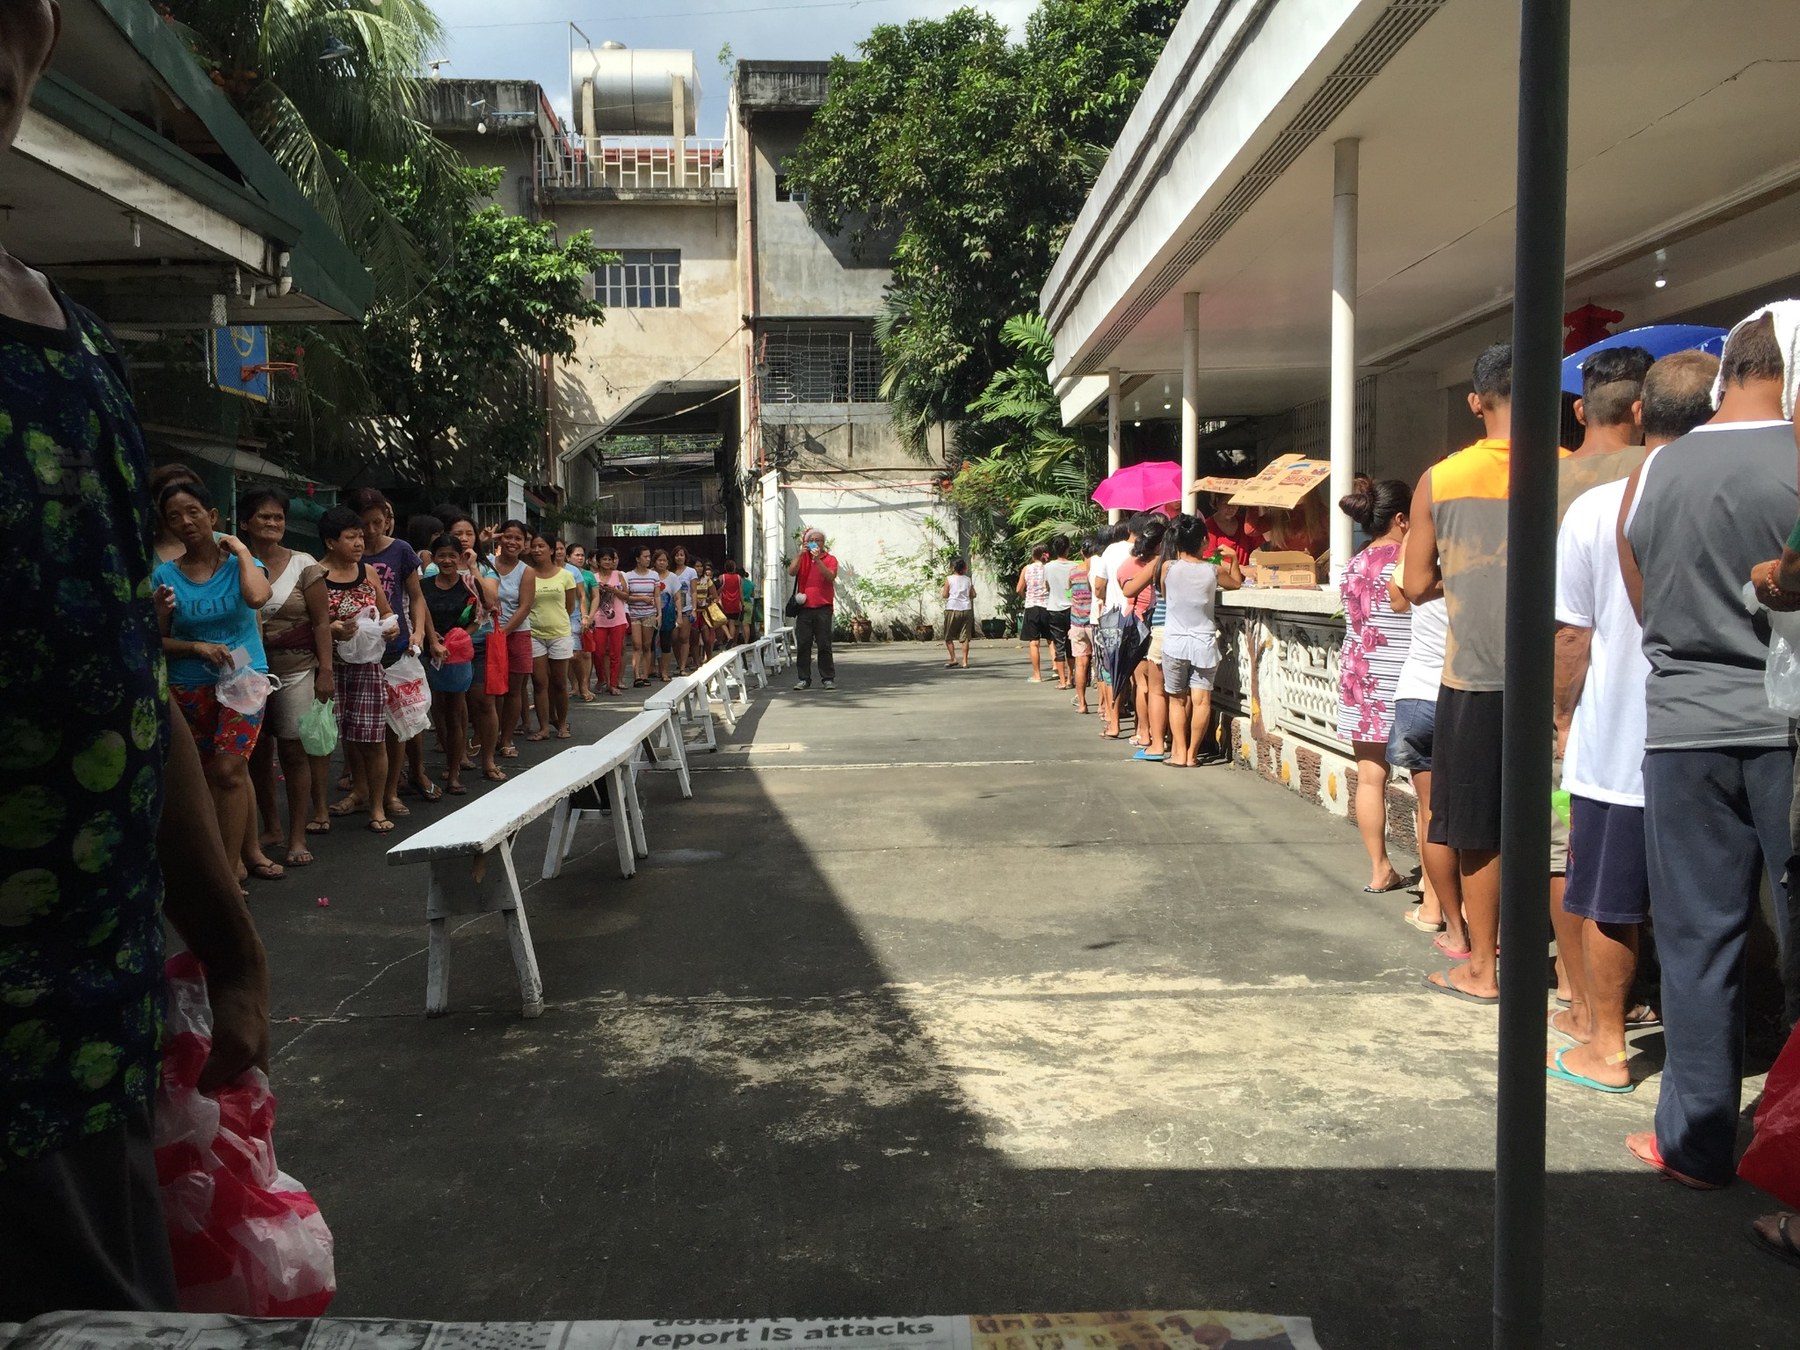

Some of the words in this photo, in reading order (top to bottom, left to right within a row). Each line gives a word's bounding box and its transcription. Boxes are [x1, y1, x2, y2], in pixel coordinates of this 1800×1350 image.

[637, 1328, 749, 1349] report
[761, 1327, 792, 1341] IS
[804, 1322, 934, 1340] attacks
